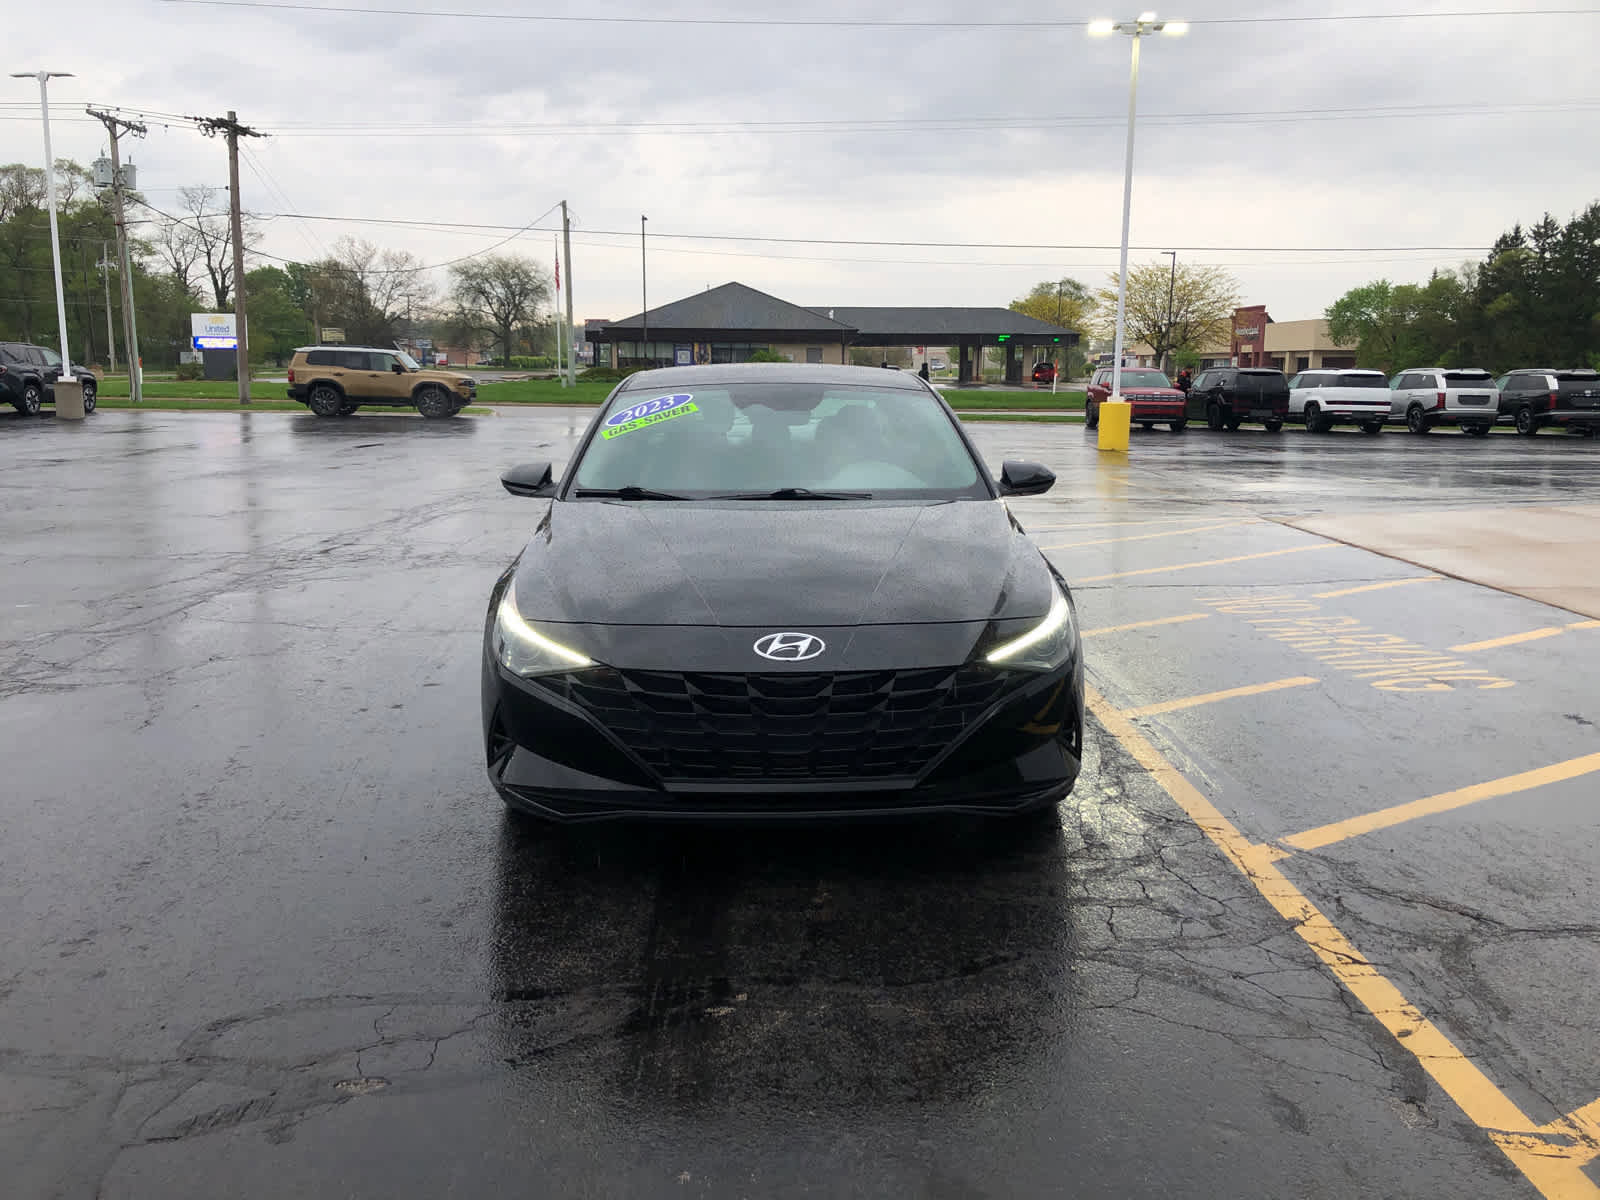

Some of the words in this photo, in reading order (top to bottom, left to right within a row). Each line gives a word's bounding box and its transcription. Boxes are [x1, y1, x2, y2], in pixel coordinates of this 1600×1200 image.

[622, 397, 675, 423] 2023
[1194, 594, 1320, 614] NO
[1244, 615, 1517, 692] PARKING
